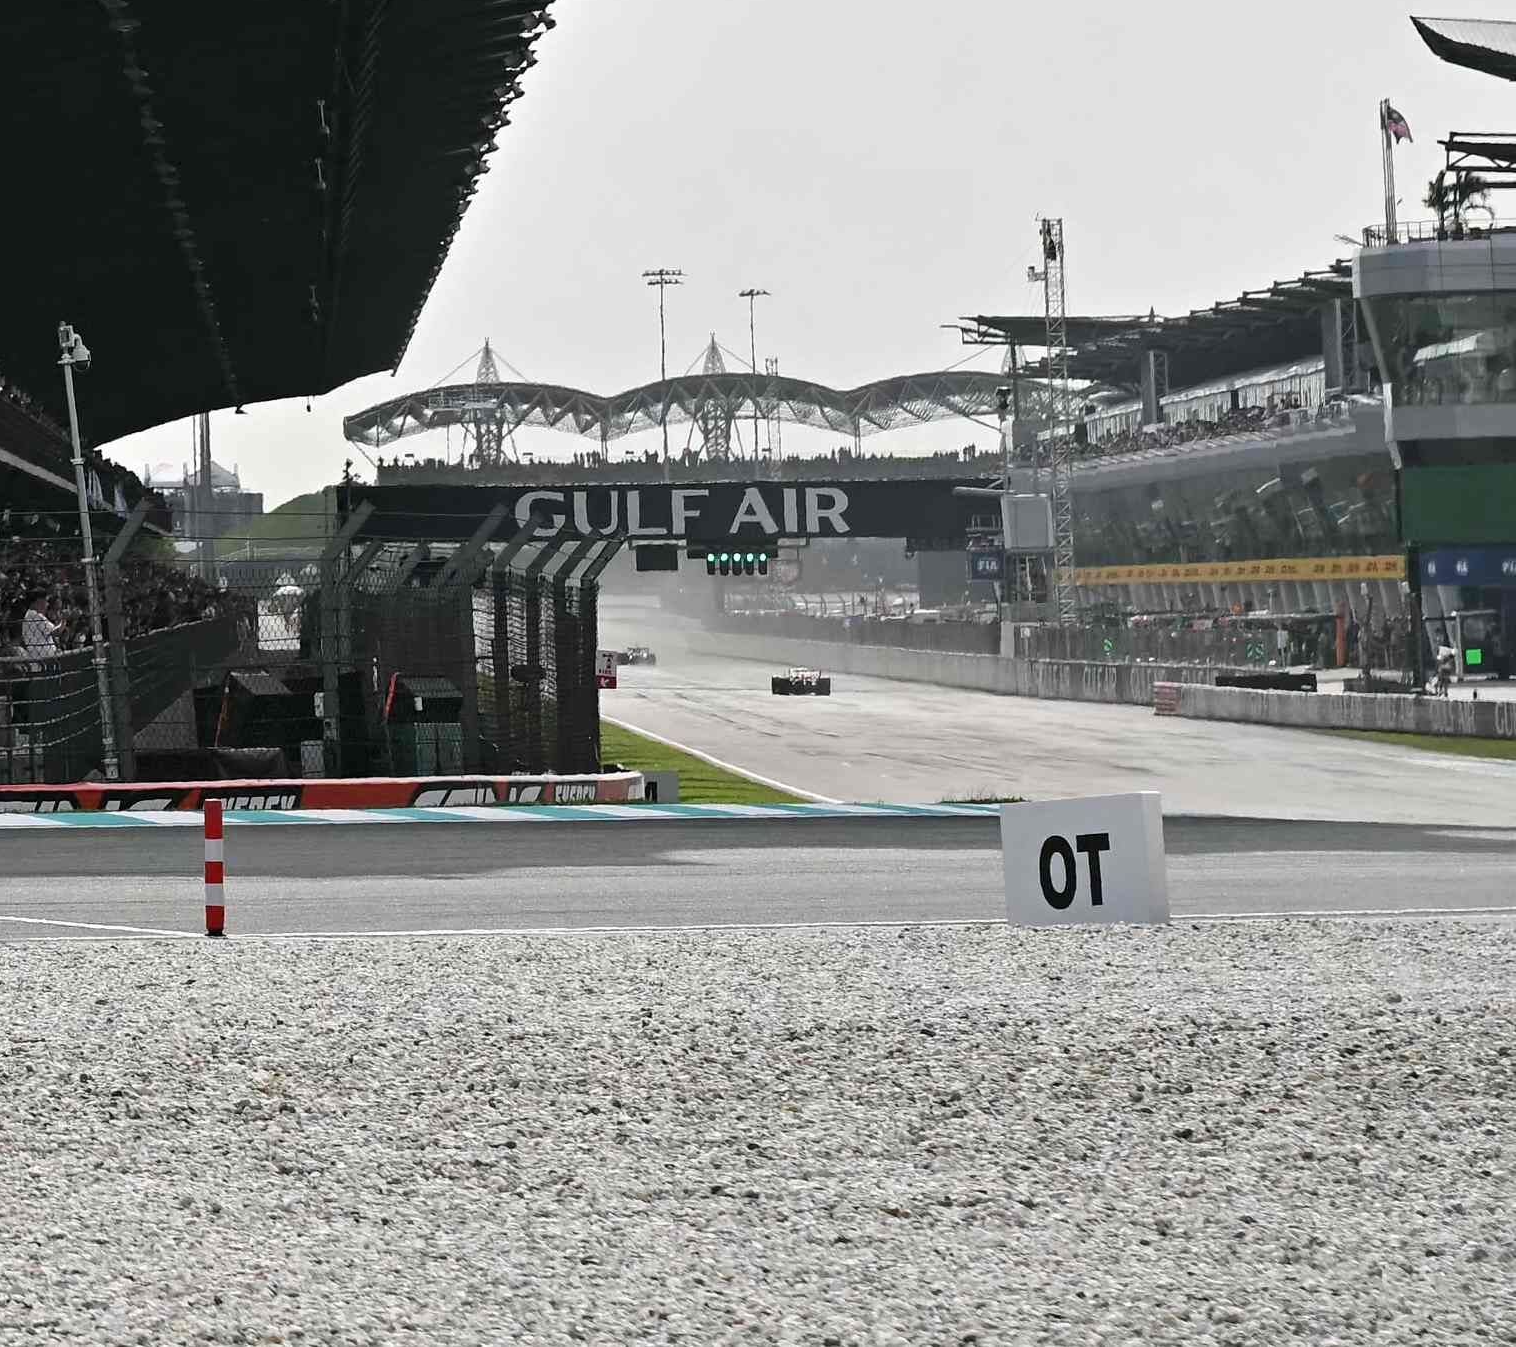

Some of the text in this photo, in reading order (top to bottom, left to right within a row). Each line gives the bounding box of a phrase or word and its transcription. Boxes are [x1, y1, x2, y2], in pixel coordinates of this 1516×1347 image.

[515, 487, 851, 537] GULF AIR
[1039, 832, 1110, 910] OT
